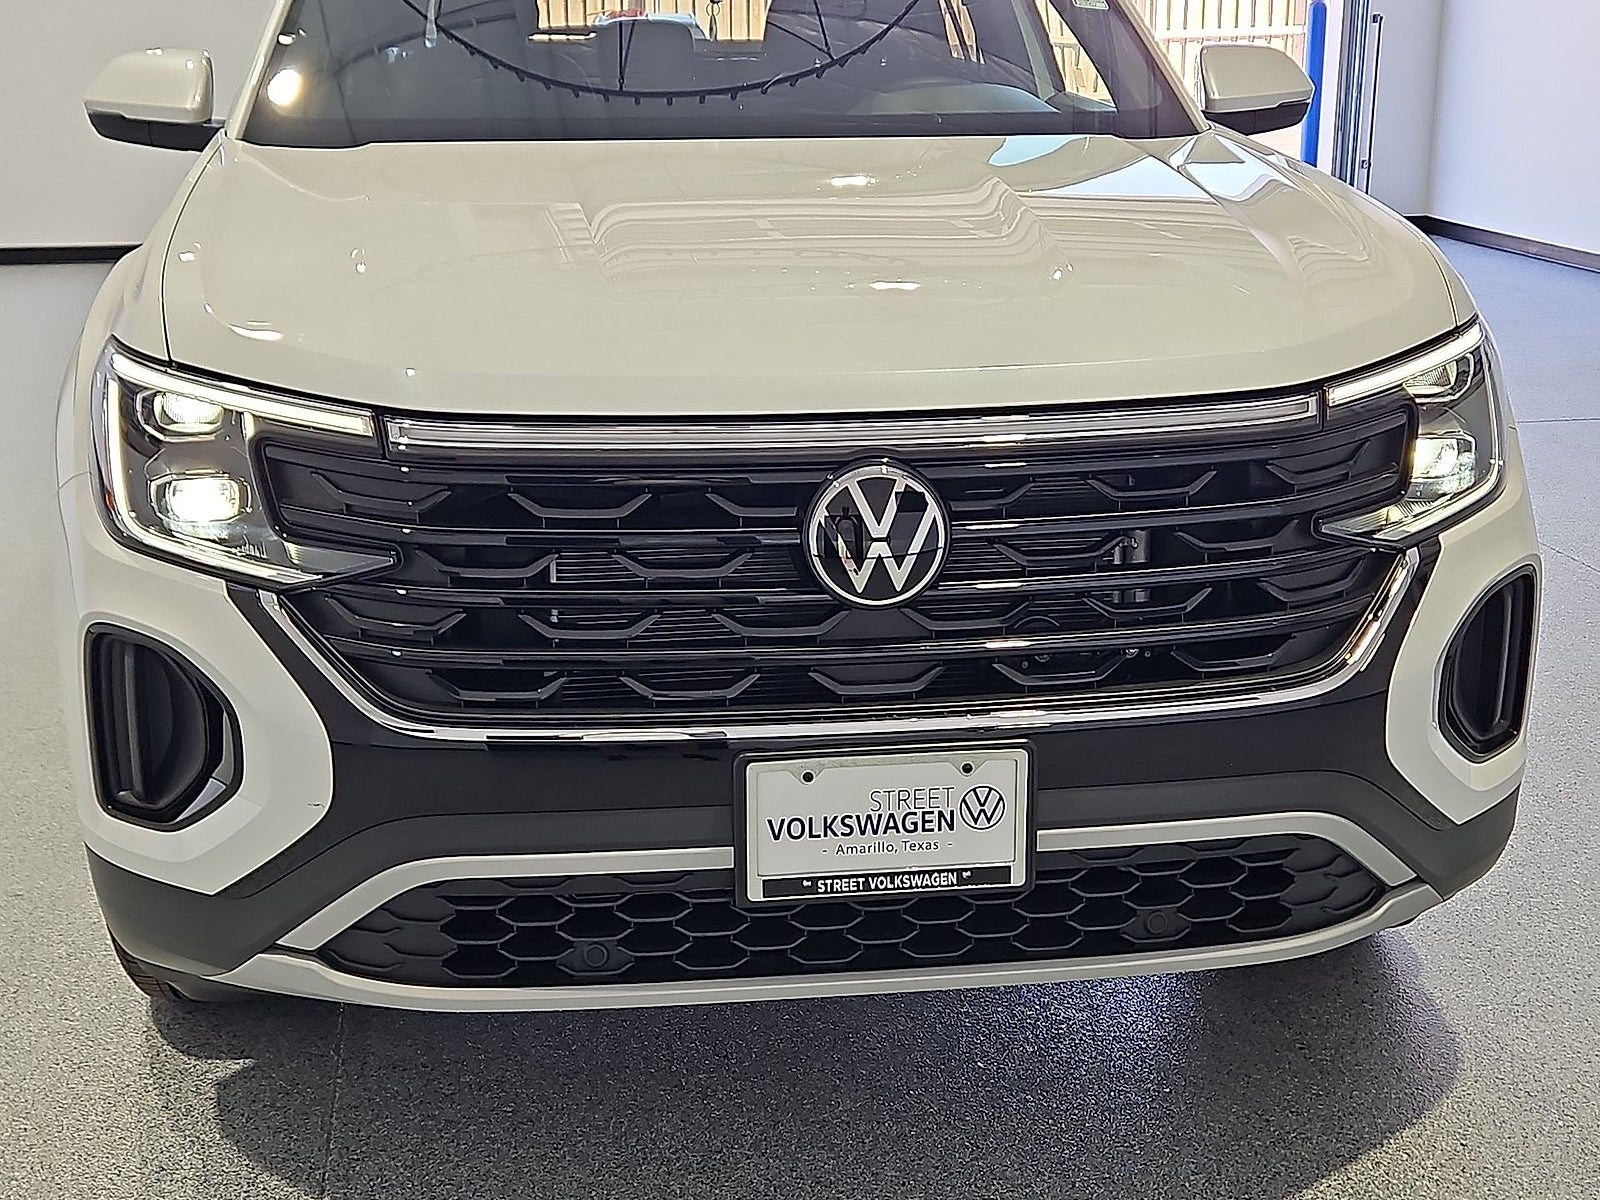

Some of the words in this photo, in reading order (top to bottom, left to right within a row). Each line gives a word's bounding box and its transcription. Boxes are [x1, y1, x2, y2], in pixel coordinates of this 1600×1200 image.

[869, 786, 955, 812] STREET
[766, 810, 955, 841] VOLKSWAGEN
[835, 842, 898, 855] Amarillo,
[901, 840, 939, 852] Texas
[817, 877, 865, 893] STREET
[868, 871, 957, 890] VOLKSWAGEN
